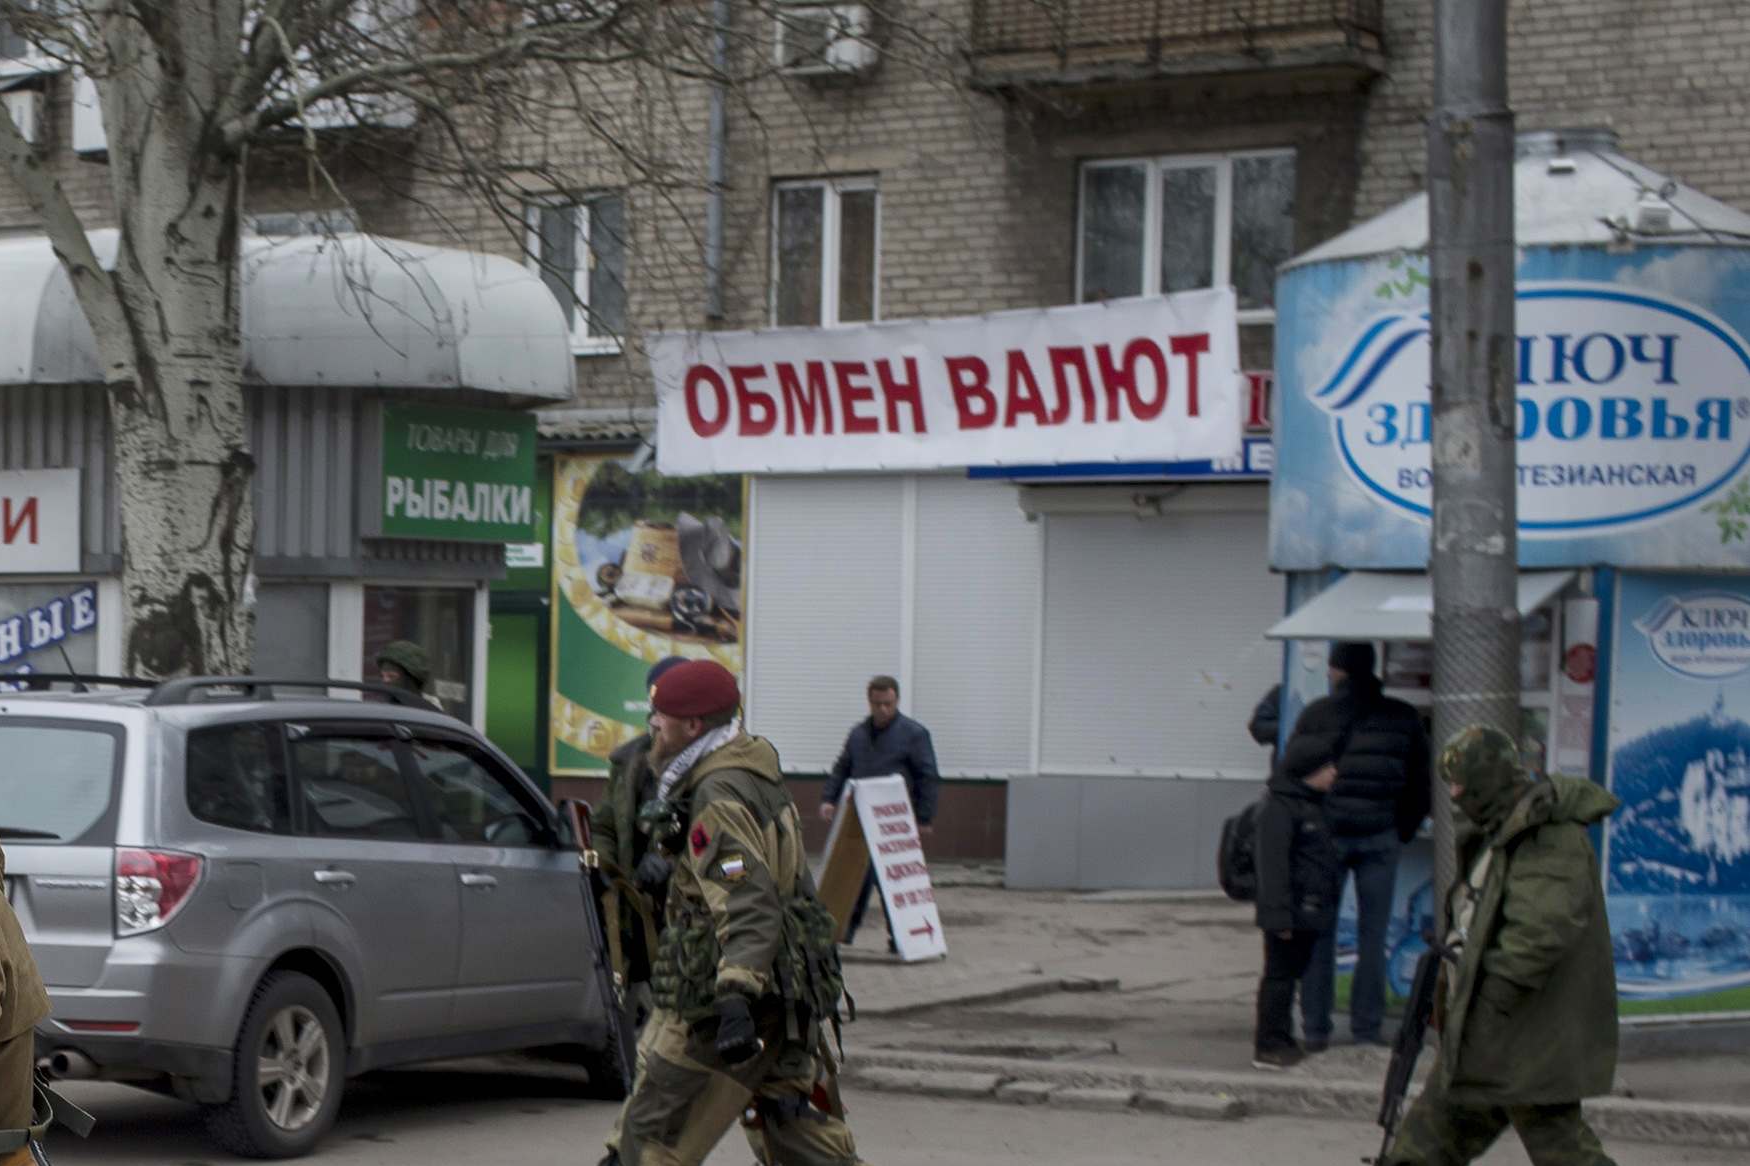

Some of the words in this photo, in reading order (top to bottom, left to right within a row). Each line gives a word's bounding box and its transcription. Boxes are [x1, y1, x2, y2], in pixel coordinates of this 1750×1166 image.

[684, 356, 928, 438] ОБМЕН
[944, 332, 1211, 430] ВАЛЮТ
[385, 475, 532, 525] РЫБАЛКИ
[1516, 463, 1697, 489] ТЕЗИАНСКАЯ
